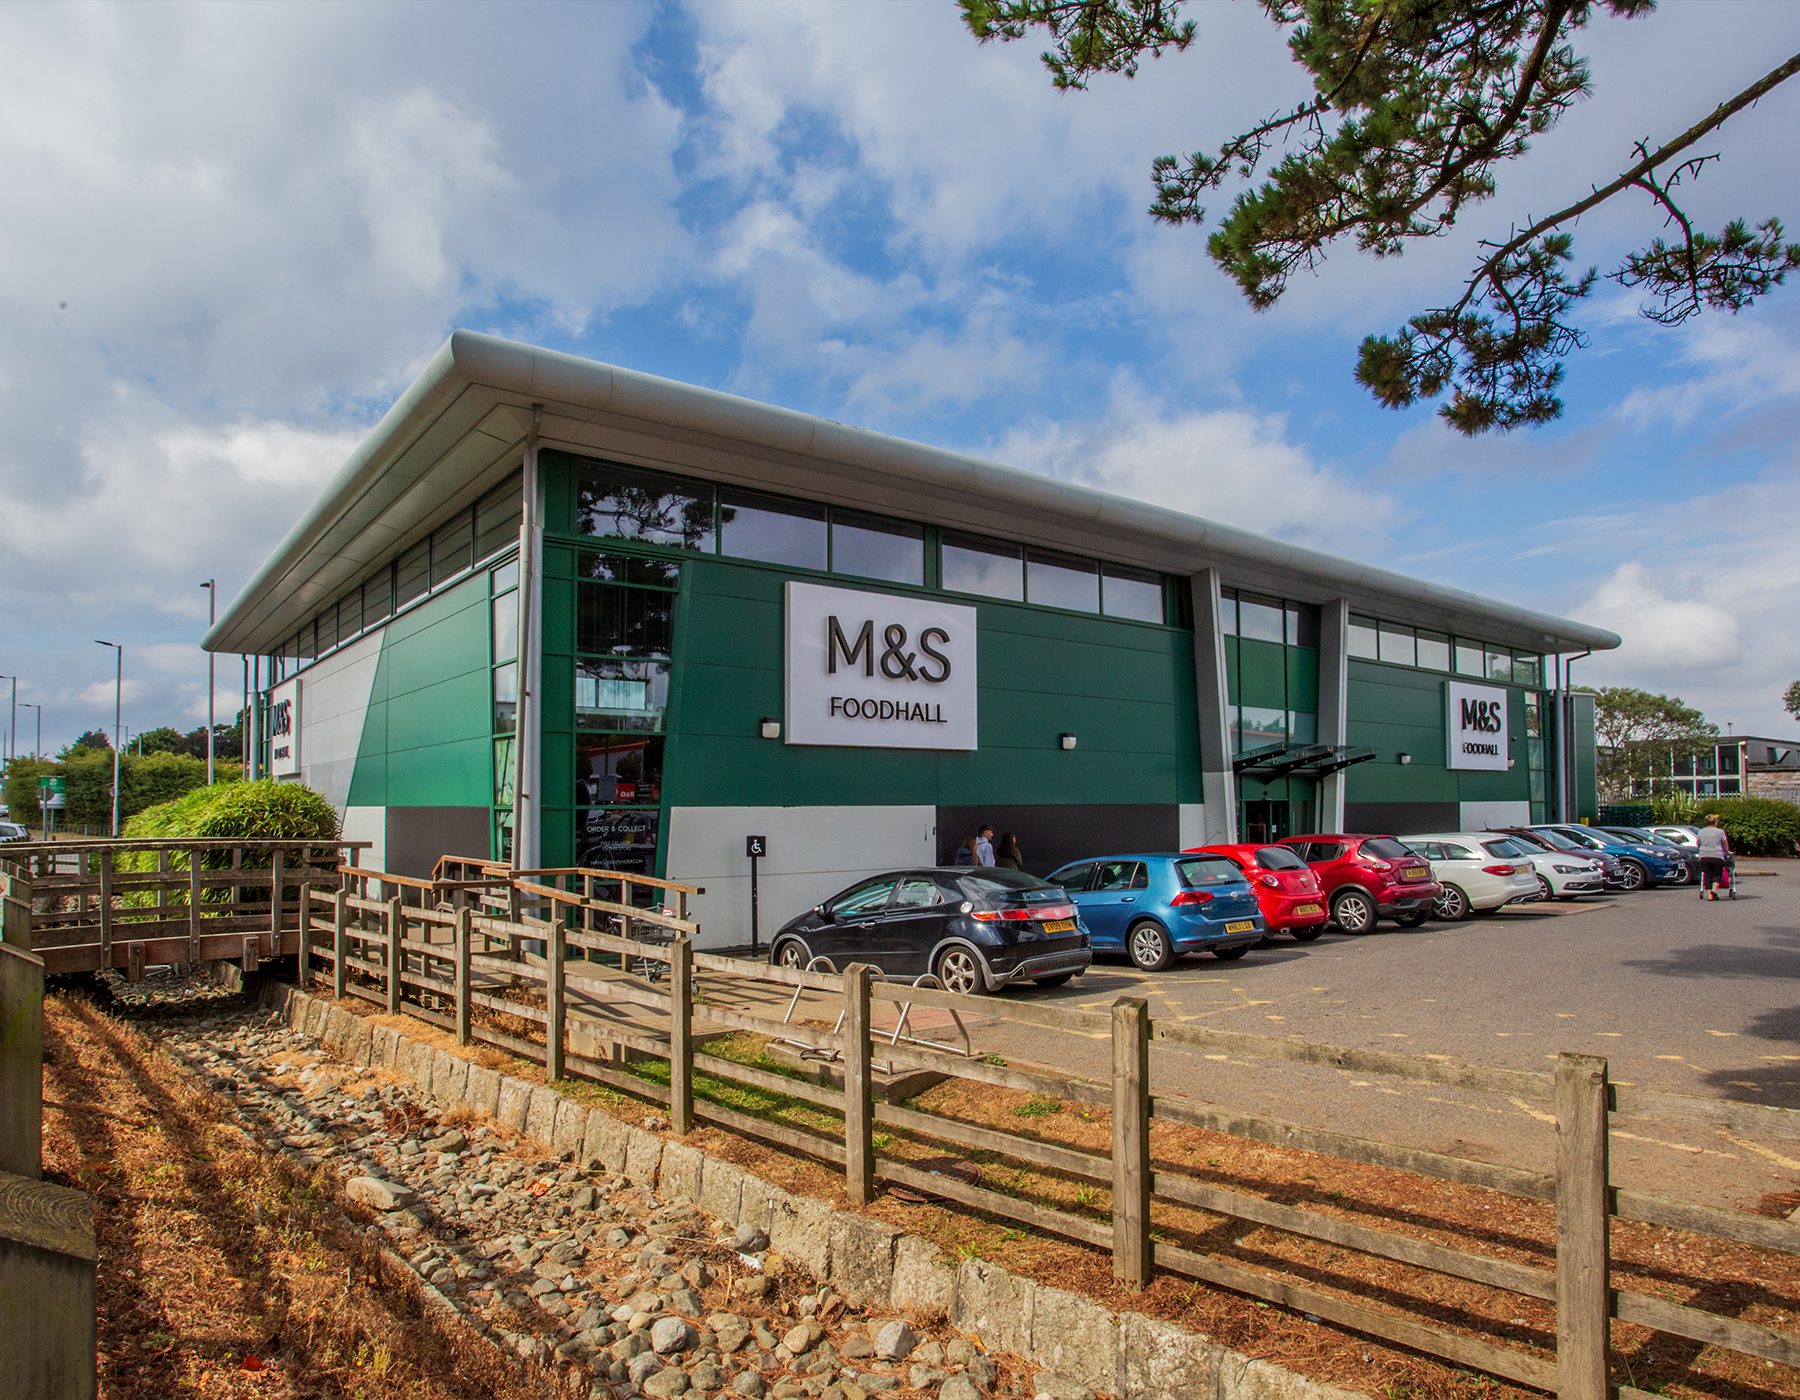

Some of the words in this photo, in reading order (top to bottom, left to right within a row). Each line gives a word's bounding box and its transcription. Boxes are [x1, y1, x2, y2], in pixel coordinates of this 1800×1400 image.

[827, 615, 952, 684] M&S
[829, 696, 948, 723] FOODHALL
[1460, 697, 1502, 733] M&S
[1462, 742, 1500, 756] FOODHALL
[586, 825, 610, 833] ORDER
